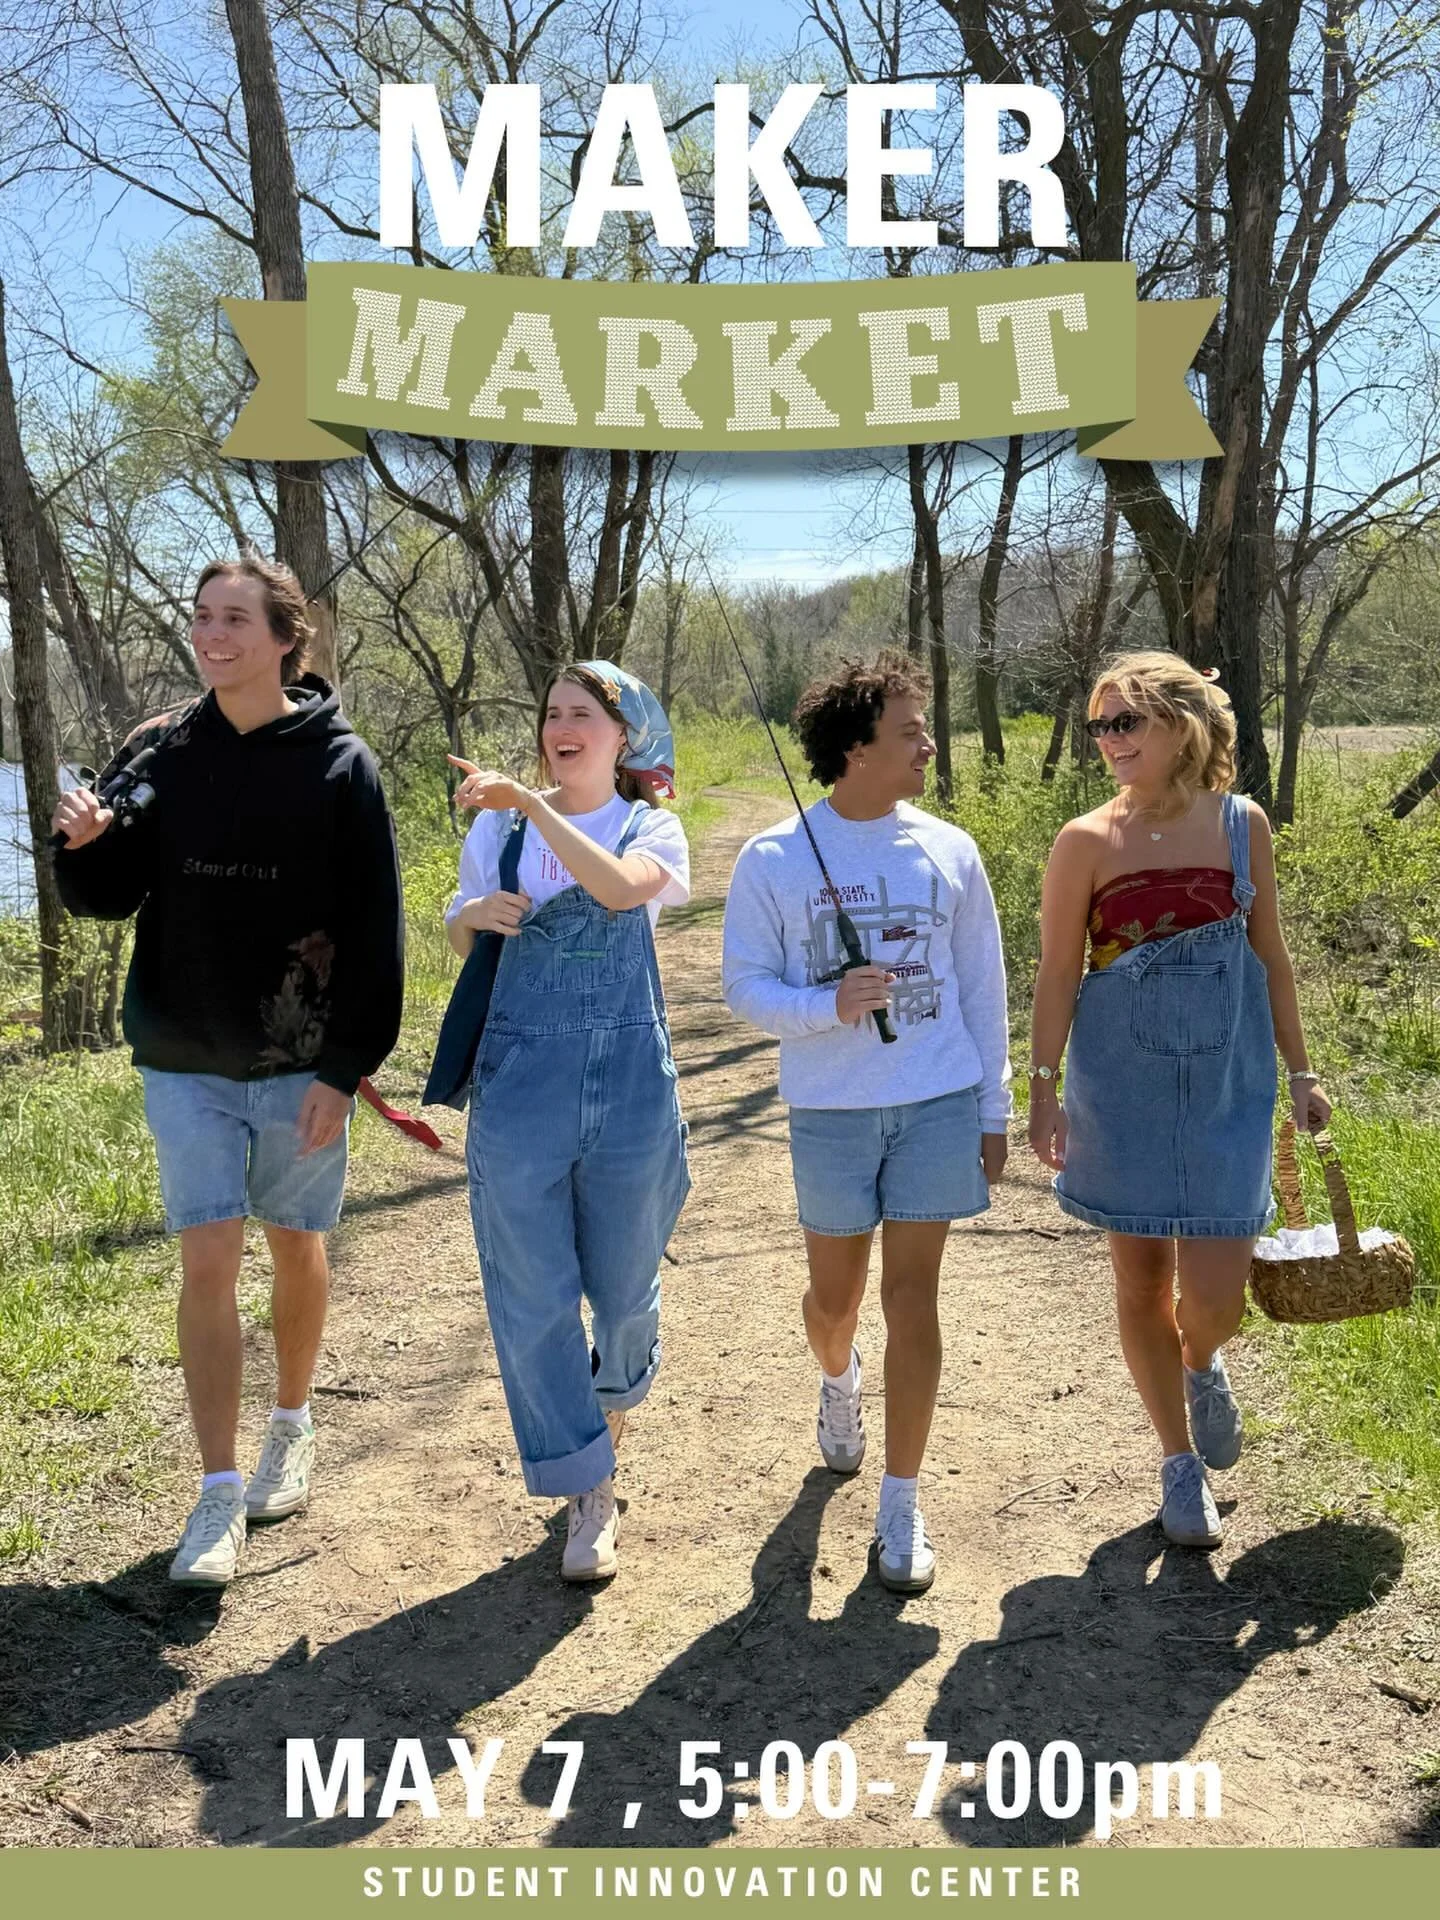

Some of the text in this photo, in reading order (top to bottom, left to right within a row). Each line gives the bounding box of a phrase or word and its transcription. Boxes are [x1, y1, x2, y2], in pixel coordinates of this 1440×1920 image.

[182, 857, 278, 880] Stand Out
[841, 885, 866, 896] STATE
[813, 893, 876, 906] UNIERSITY
